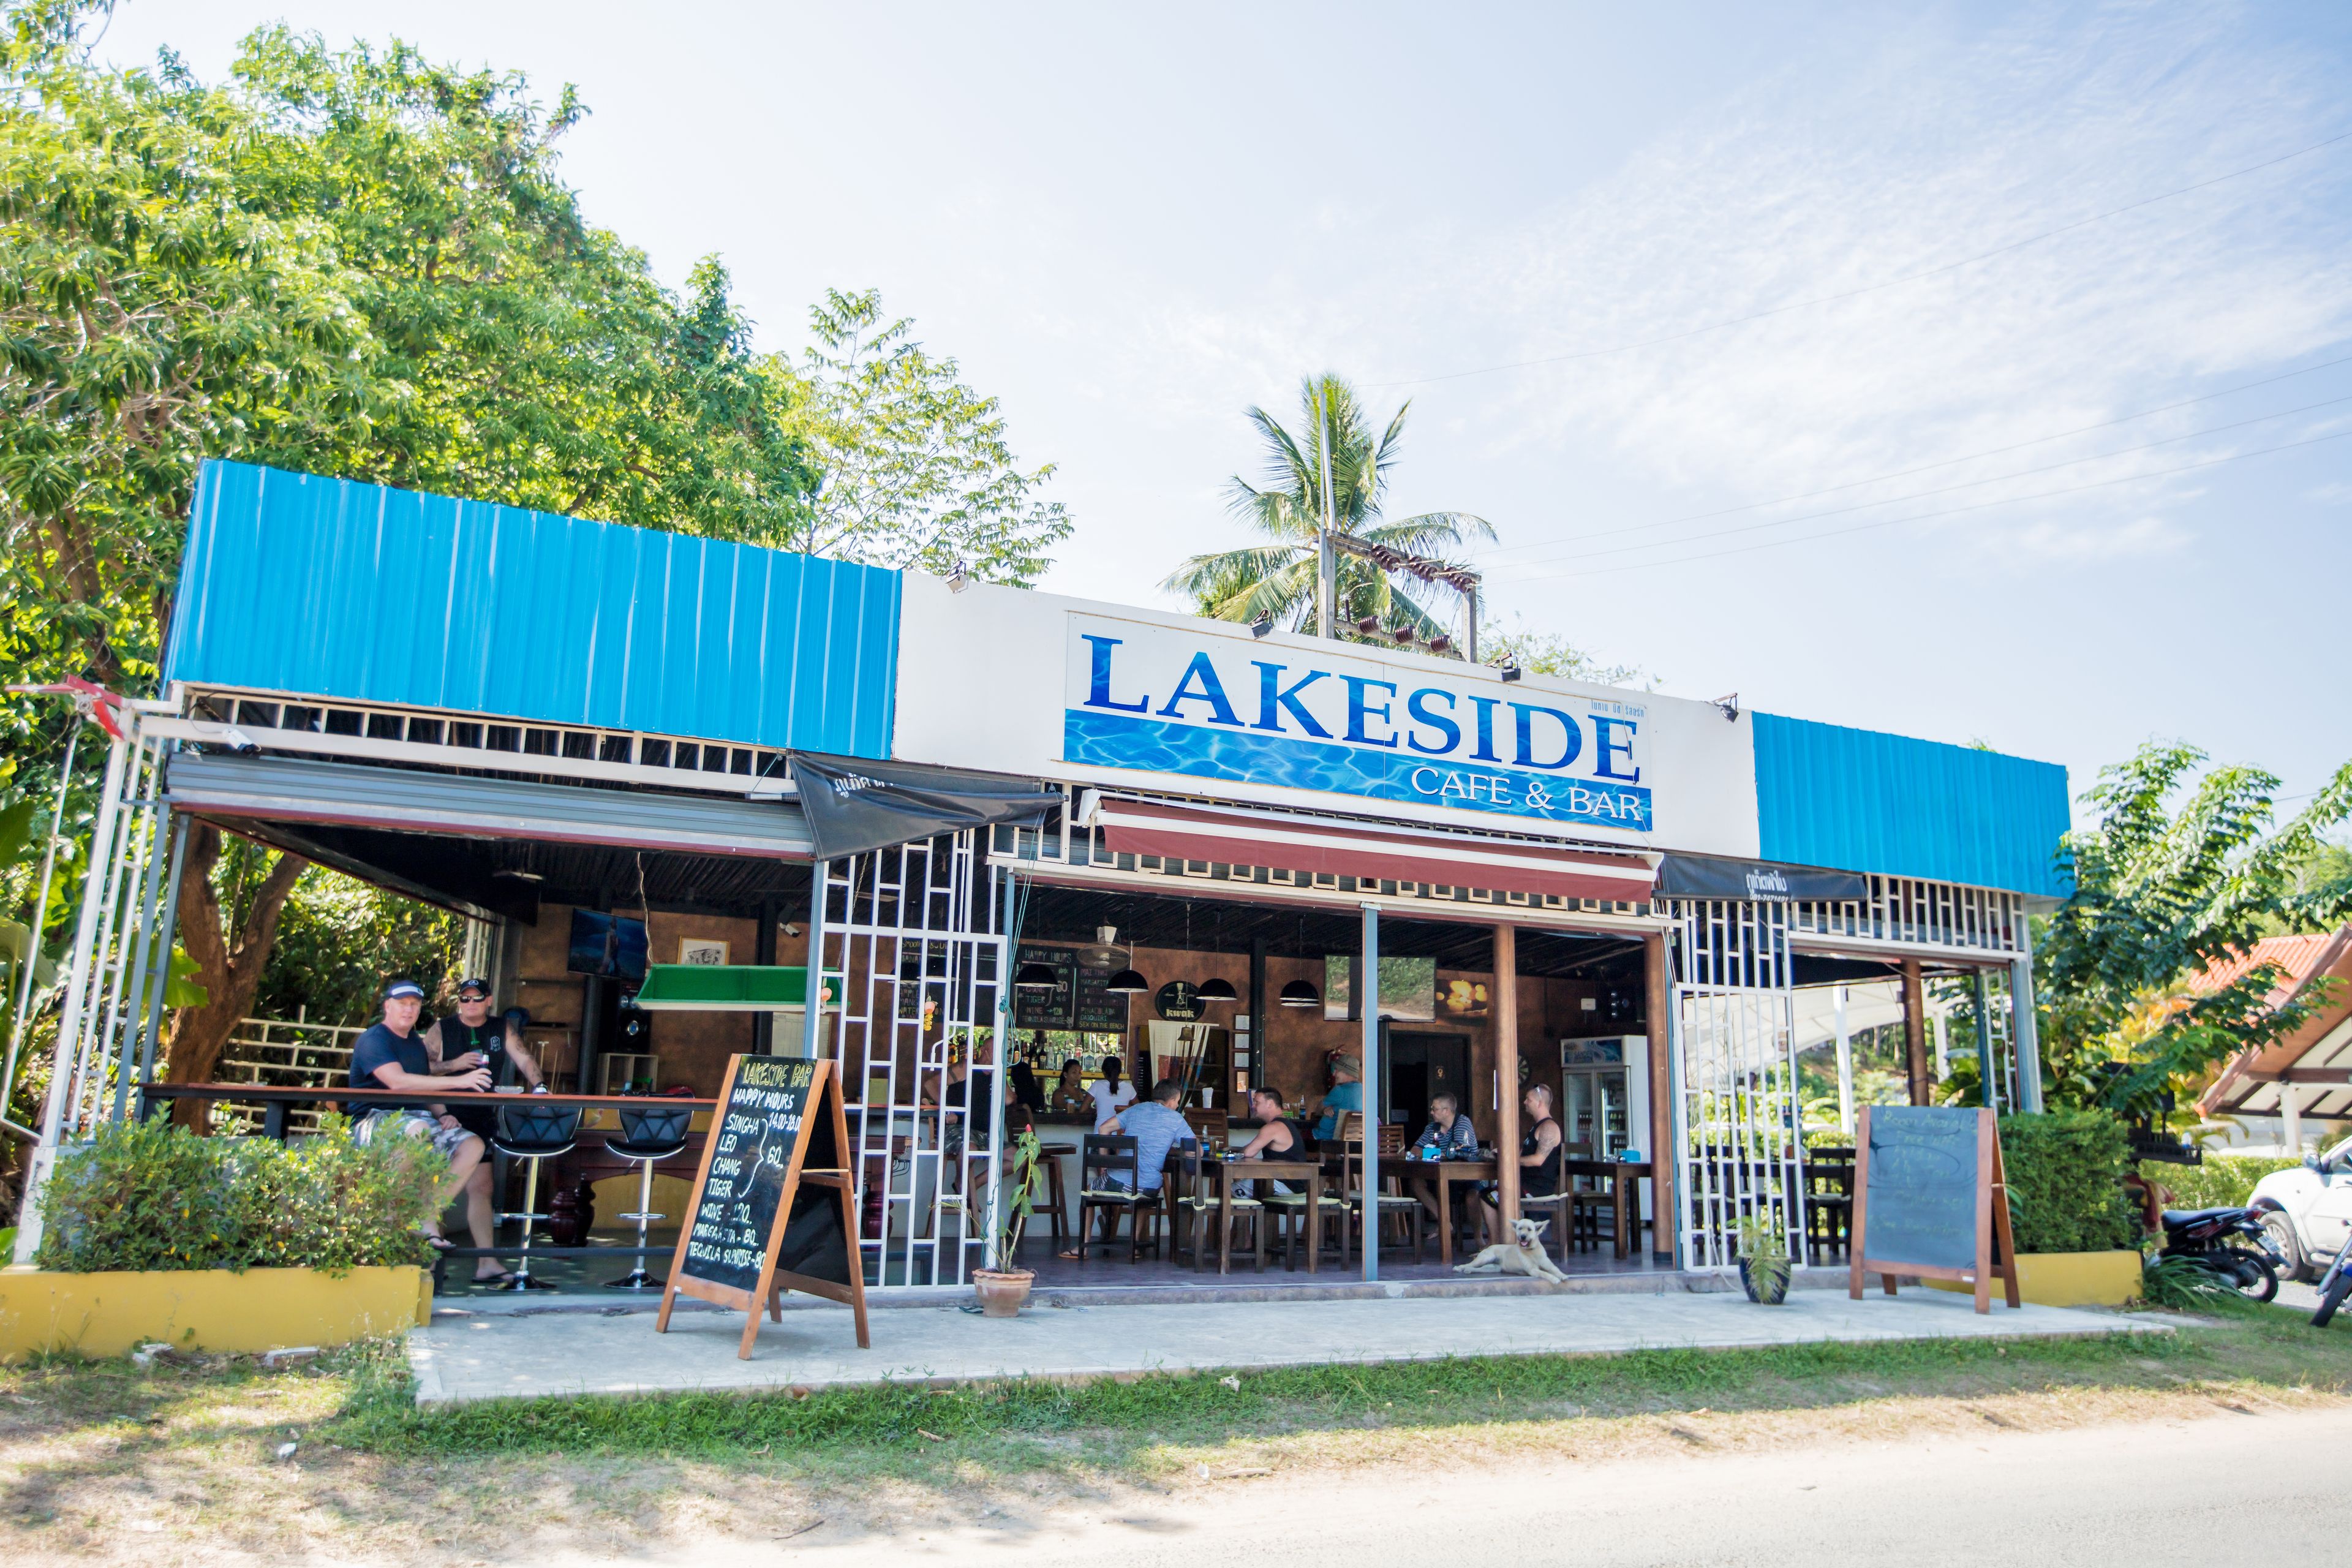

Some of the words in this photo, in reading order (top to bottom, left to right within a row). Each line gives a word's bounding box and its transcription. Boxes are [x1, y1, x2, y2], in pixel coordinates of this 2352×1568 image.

[1082, 634, 1640, 783] LAKESIDE
[1411, 767, 1512, 807] CAFE
[1525, 782, 1556, 811] &
[1568, 788, 1643, 823] BAR
[1025, 949, 1046, 962] HAPPY
[1050, 951, 1072, 963] HOURS
[1026, 995, 1045, 1004] TIGER
[742, 1063, 789, 1087] LAKESIDE
[790, 1063, 813, 1088] BAR
[733, 1088, 766, 1108] HAPPY
[764, 1091, 795, 1110] HOURS
[725, 1113, 760, 1135] SINGHA
[719, 1134, 737, 1153] LEO
[713, 1156, 742, 1176] CHANG
[709, 1178, 733, 1198] TIGER
[701, 1202, 725, 1221] WINE
[689, 1241, 721, 1261] TEQUILA
